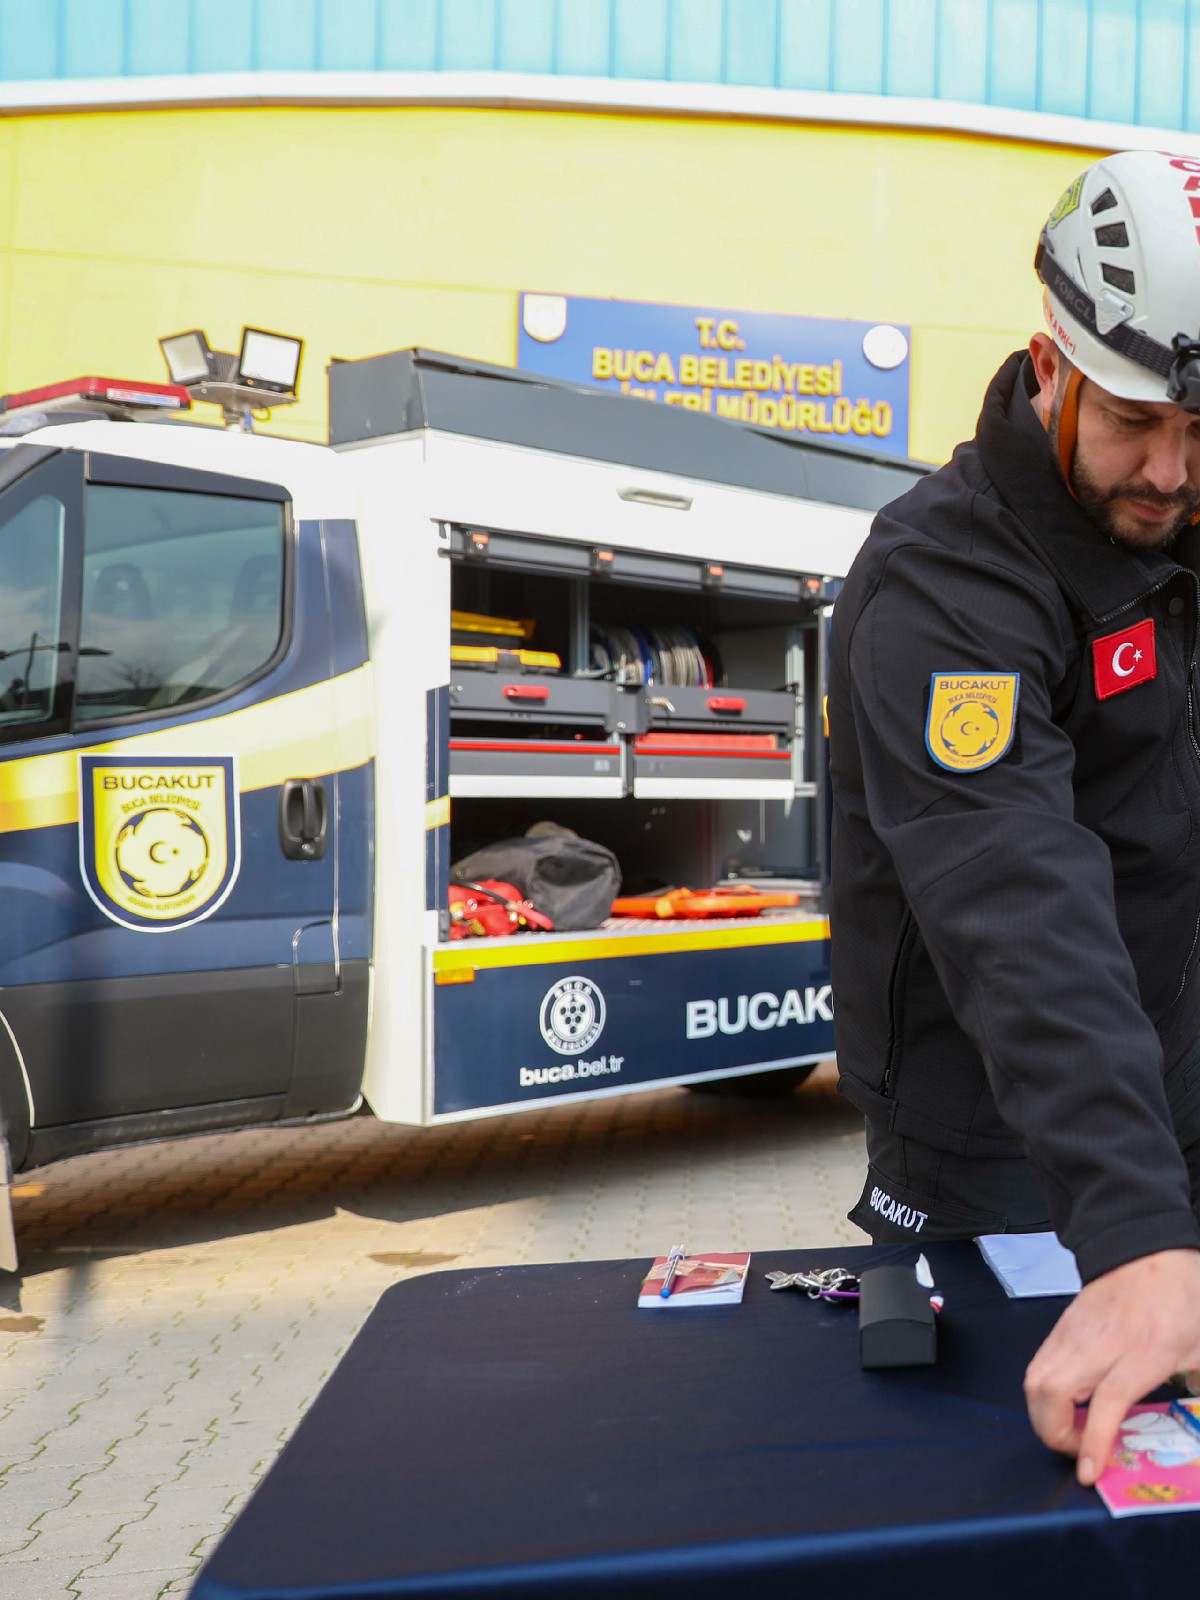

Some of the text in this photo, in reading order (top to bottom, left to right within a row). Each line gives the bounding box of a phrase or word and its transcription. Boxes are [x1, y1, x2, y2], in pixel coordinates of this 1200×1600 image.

[695, 317, 746, 351] T.C.
[592, 347, 843, 397] BUCA BELEDİYESİ
[716, 391, 893, 437] MÜDÜRLÜĞÜ
[940, 680, 1010, 690] BUCAKUT
[102, 775, 216, 791] BUCAKUT
[519, 1055, 625, 1087] buca.bel.tr
[869, 1186, 929, 1233] BUCAKUT
